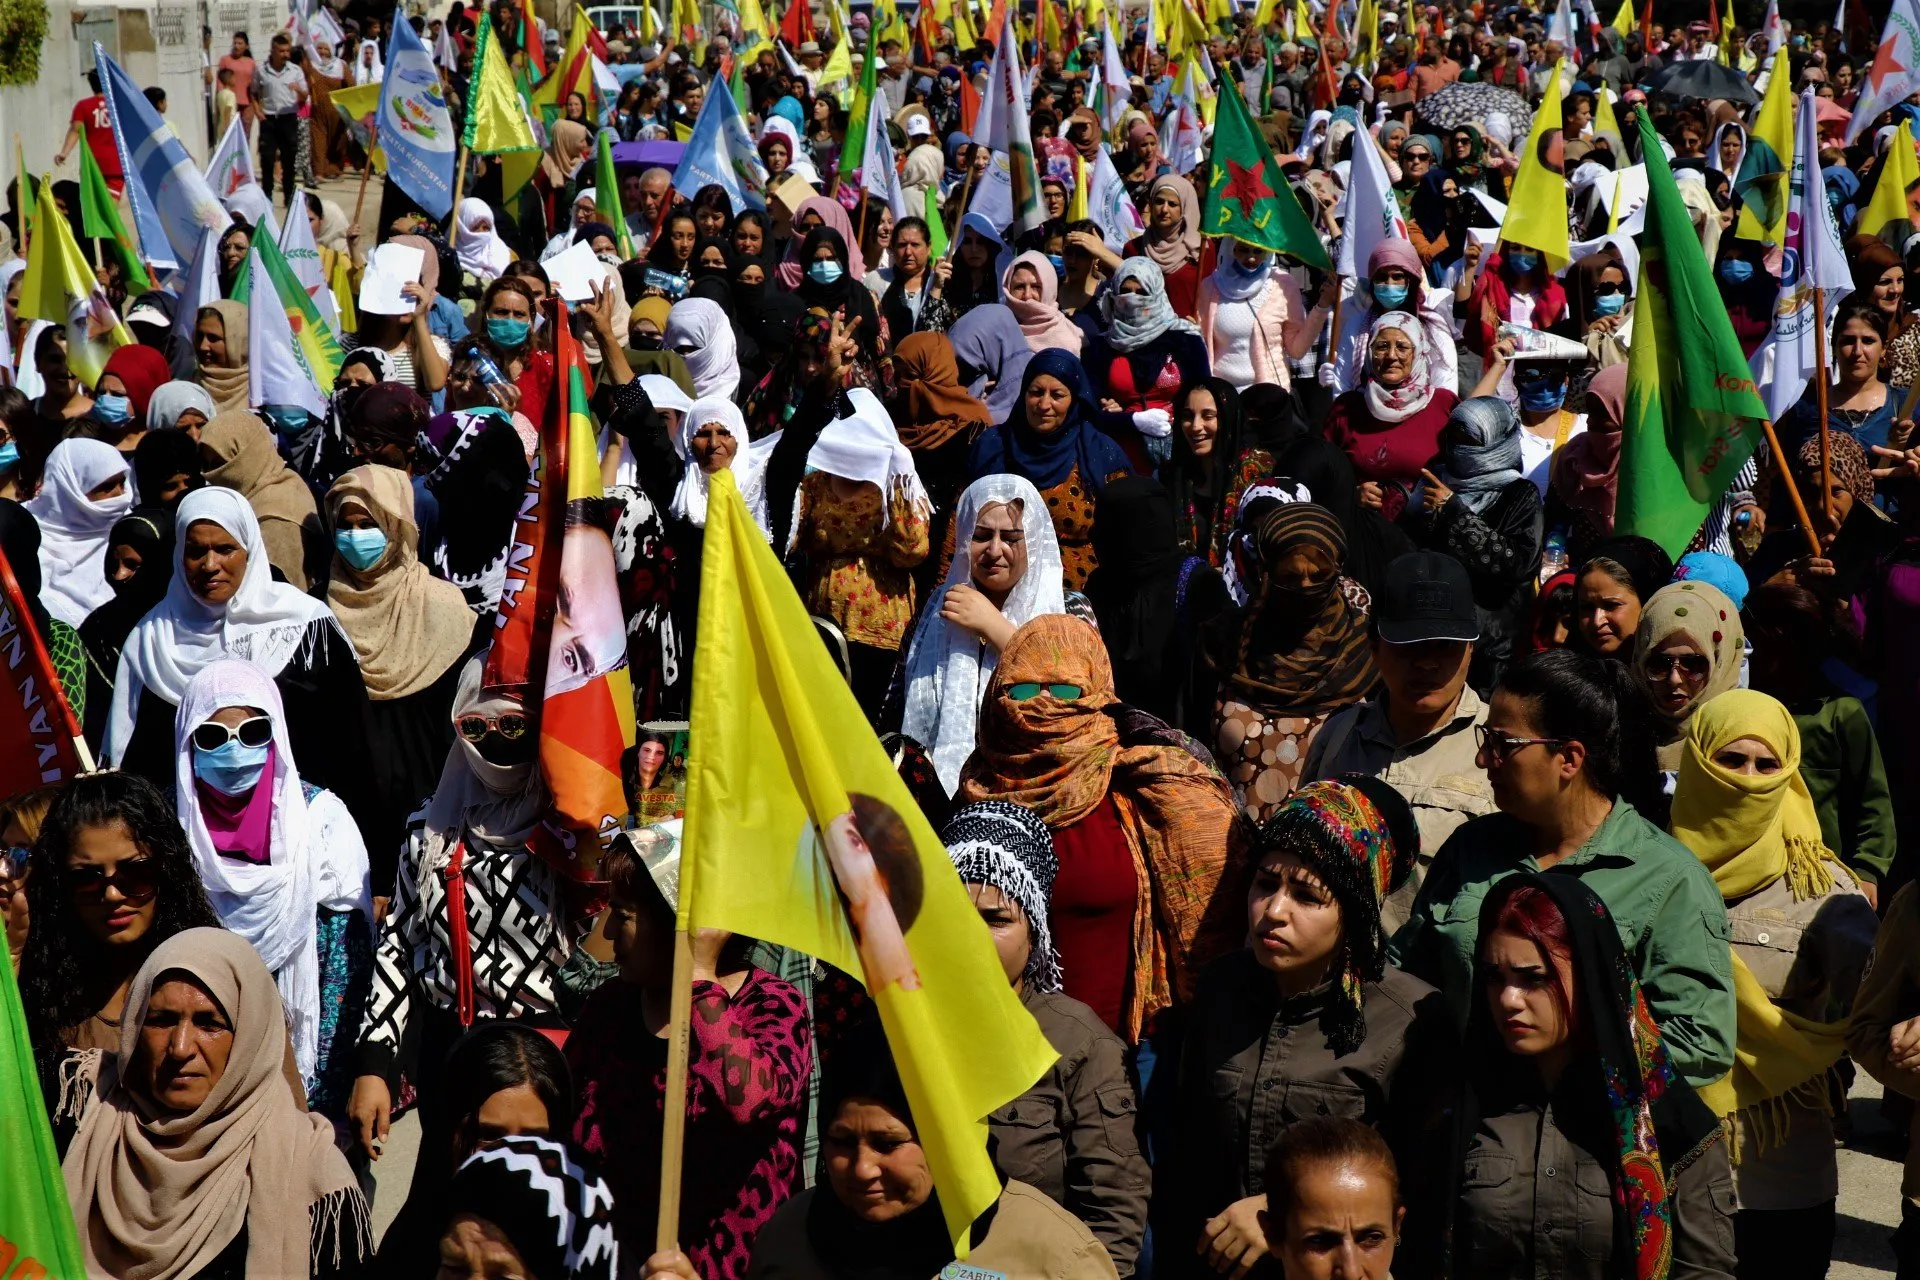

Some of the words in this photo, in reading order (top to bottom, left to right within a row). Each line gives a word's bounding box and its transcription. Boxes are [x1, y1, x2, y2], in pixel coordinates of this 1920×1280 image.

[406, 152, 448, 191] KURDISTAN
[519, 436, 541, 523] NA
[0, 592, 27, 671] NA
[18, 674, 62, 785] IYAN
[635, 791, 676, 803] AVESTA
